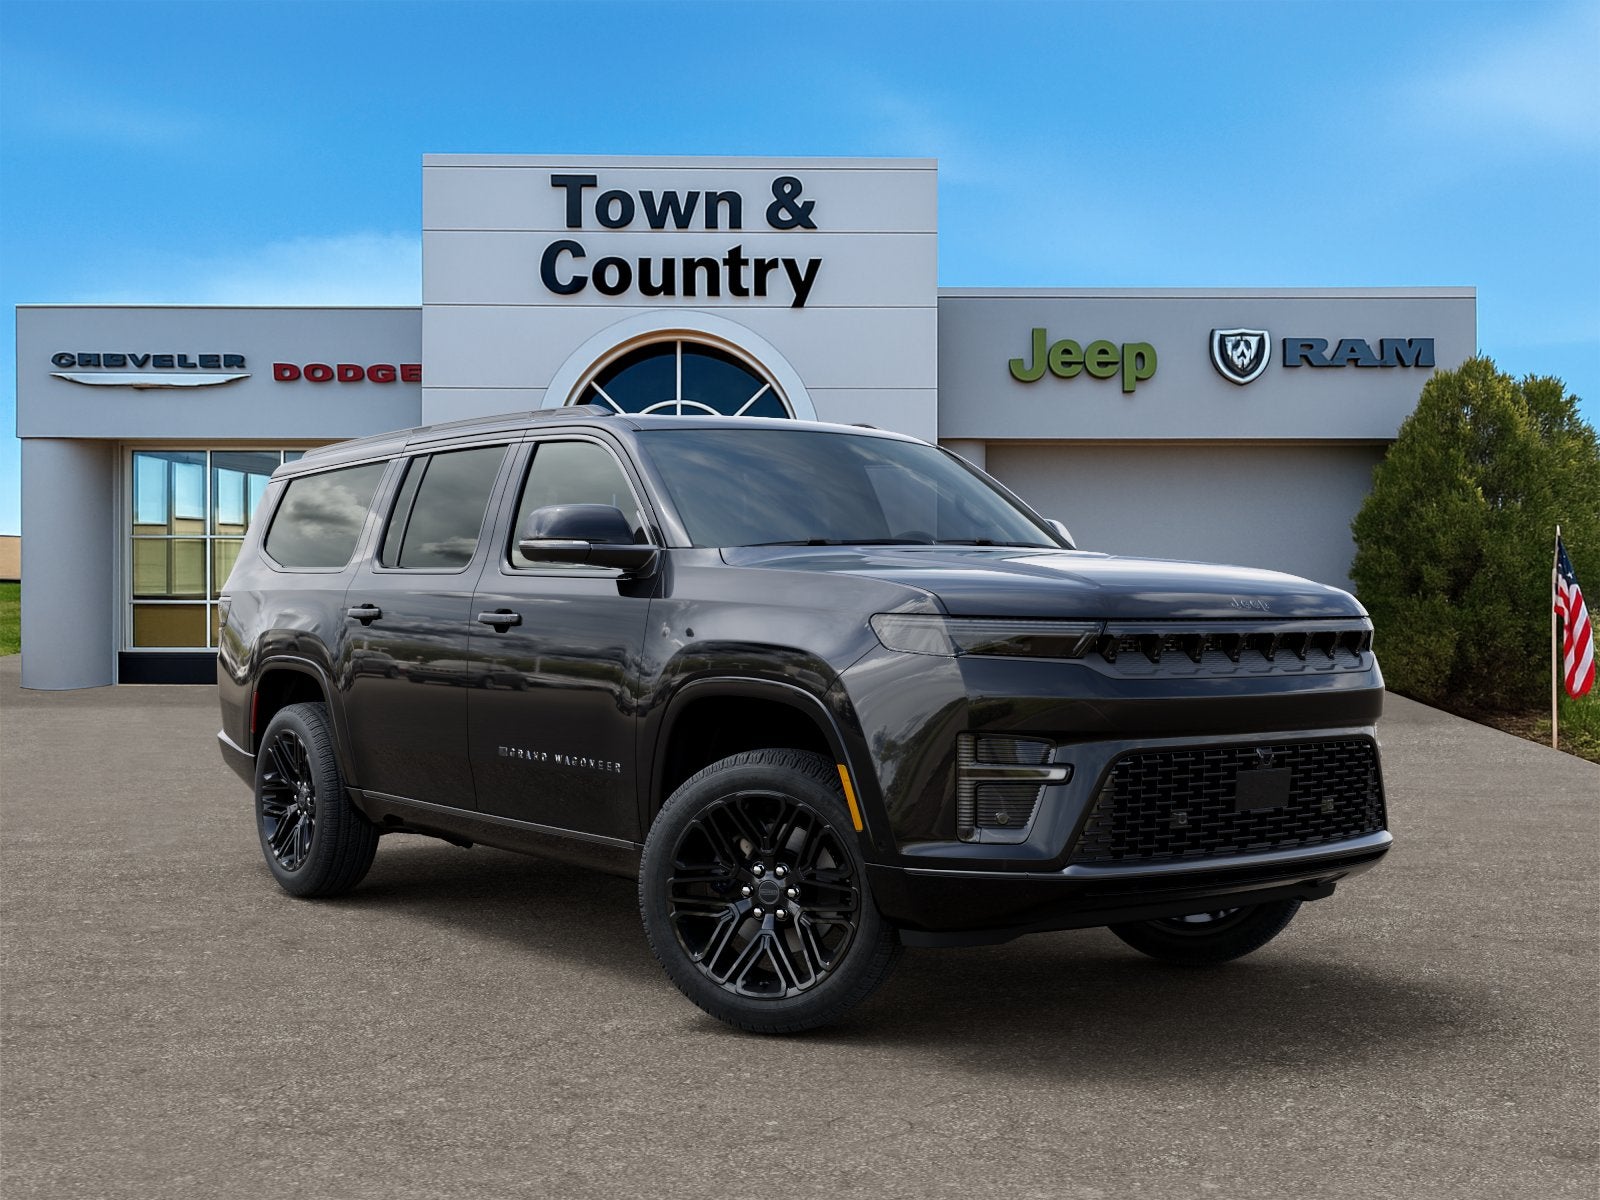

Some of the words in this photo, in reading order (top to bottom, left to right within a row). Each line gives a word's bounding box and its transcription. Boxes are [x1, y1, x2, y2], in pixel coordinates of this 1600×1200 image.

[550, 174, 743, 230] Town
[765, 175, 819, 231] &
[539, 238, 823, 309] Country
[272, 362, 422, 384] DODGE
[1008, 327, 1158, 393] Jeep
[1282, 337, 1436, 369] RAM
